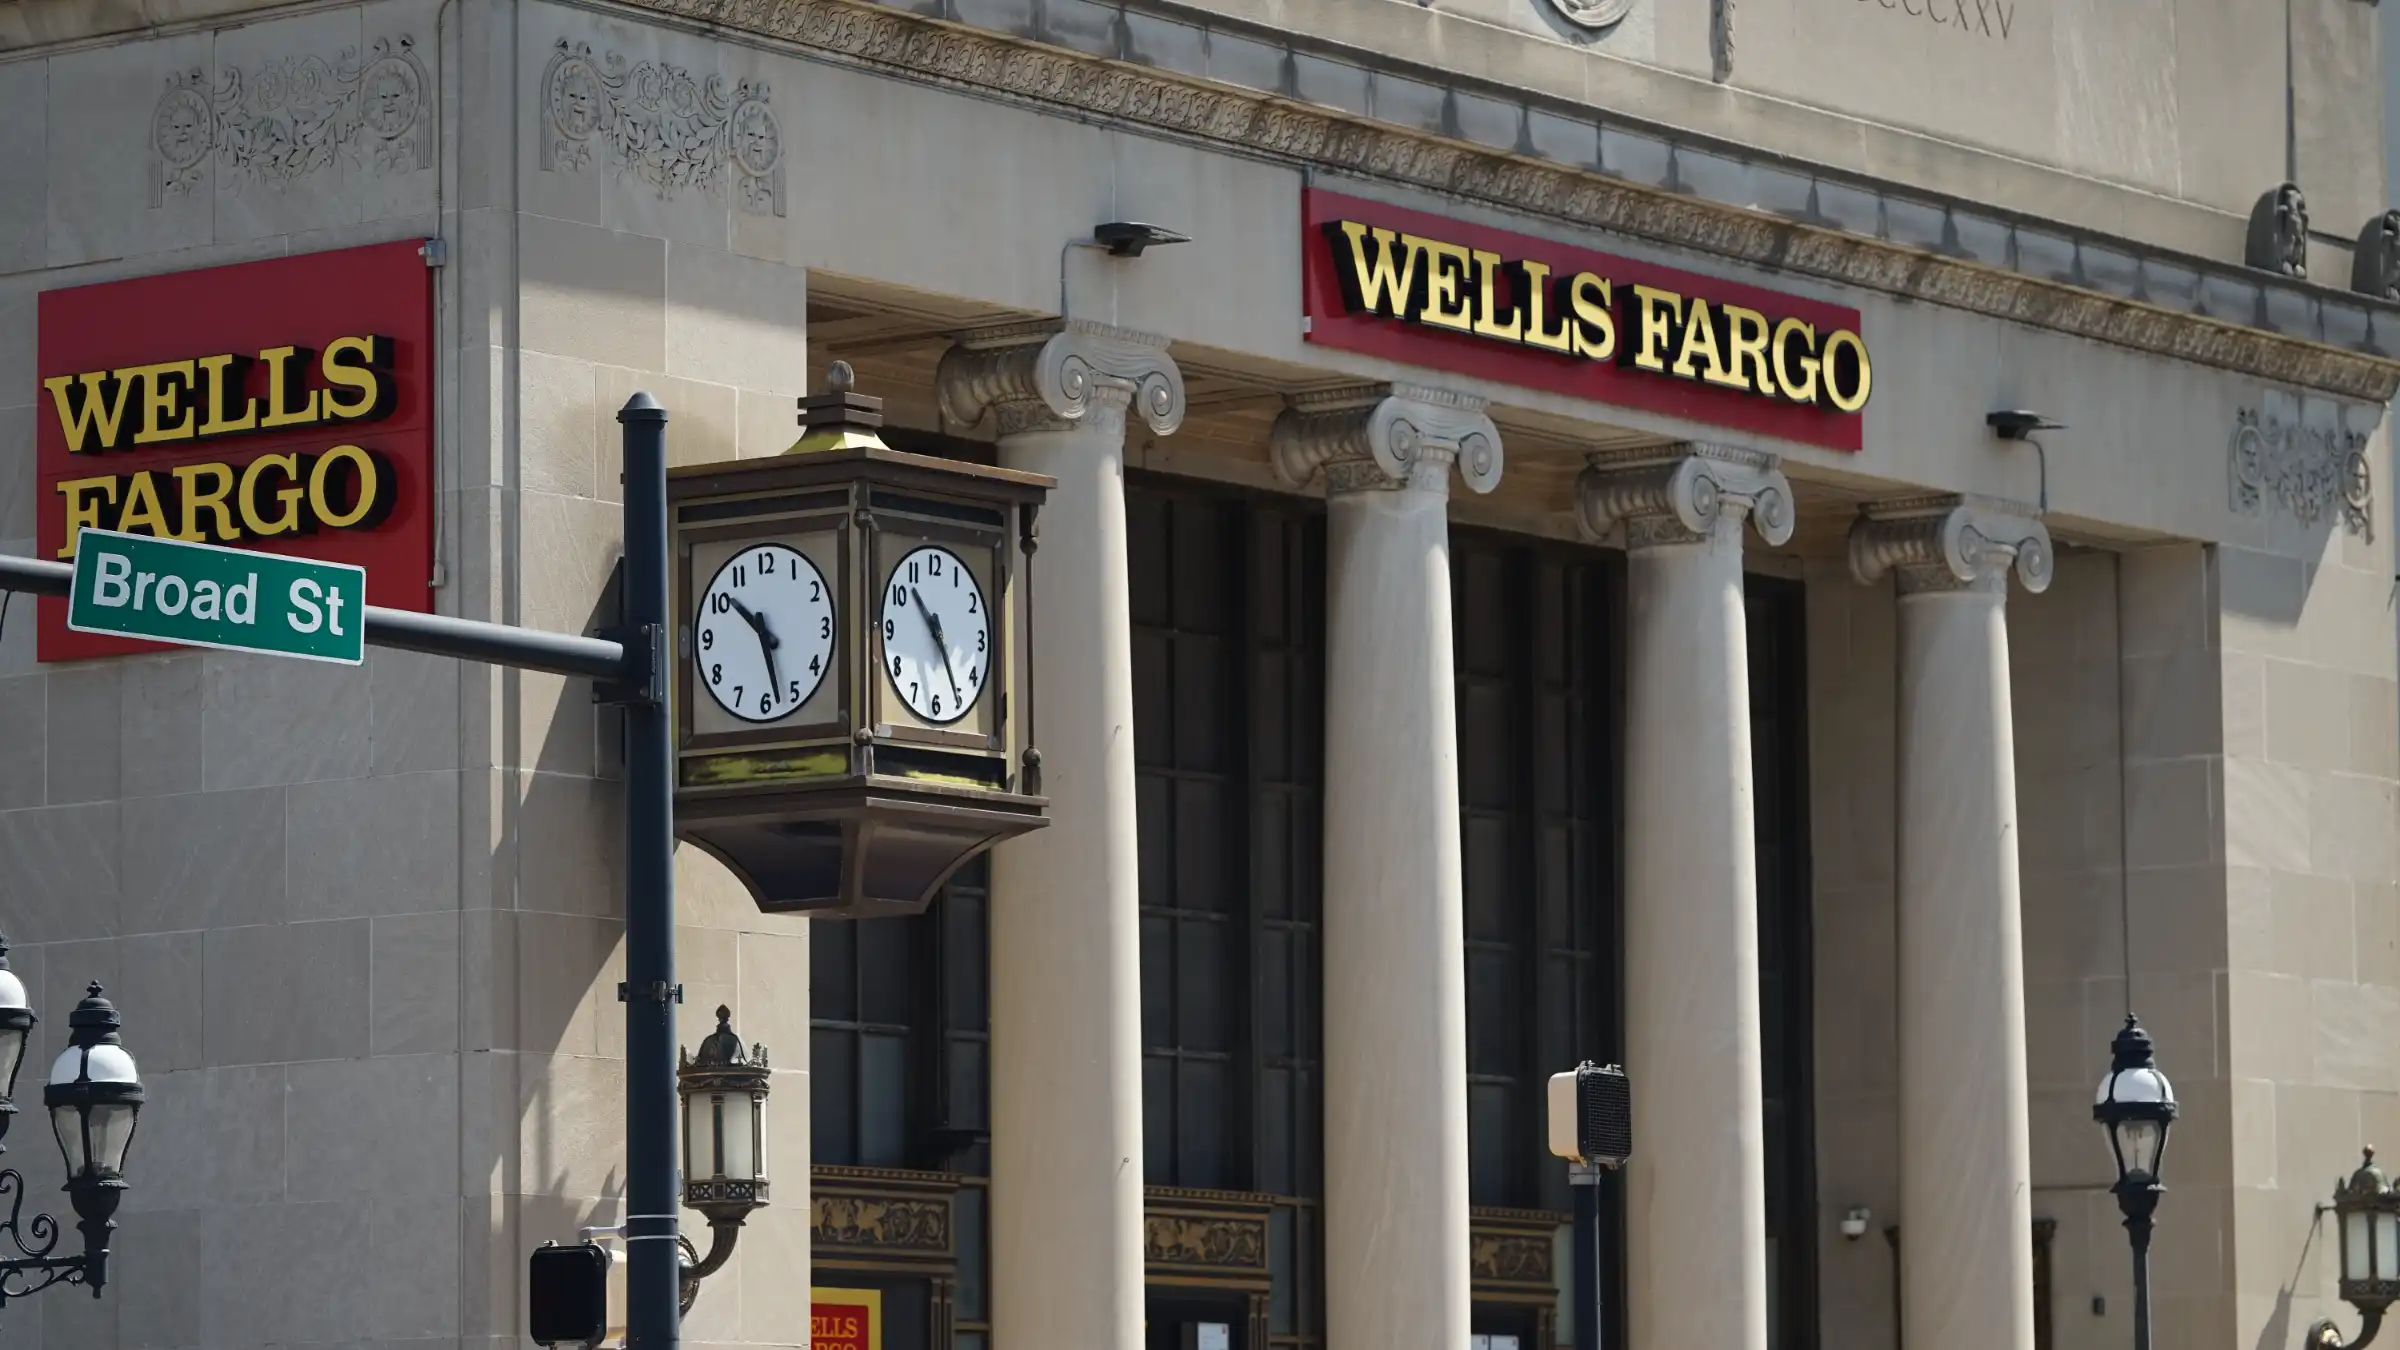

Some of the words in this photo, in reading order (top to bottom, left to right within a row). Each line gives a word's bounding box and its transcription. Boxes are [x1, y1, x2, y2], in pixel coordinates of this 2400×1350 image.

[1341, 219, 1616, 361] WELLS
[1633, 284, 1873, 413] FARGO
[43, 333, 379, 454] WELLS
[56, 444, 378, 560] FARGO
[758, 552, 775, 575] 12
[791, 558, 796, 581] 1
[908, 561, 919, 584] 11
[928, 554, 942, 576] 12
[732, 565, 746, 588] 11
[953, 566, 958, 588] 1
[91, 551, 258, 626] Broad
[286, 576, 345, 637] St
[809, 580, 821, 603] 2
[892, 584, 907, 607] 10
[968, 592, 977, 614] 2
[711, 592, 731, 615] 10
[820, 616, 831, 640] 3
[885, 619, 895, 641] 9
[701, 629, 714, 651] 9
[977, 630, 986, 653] 3
[711, 663, 723, 685] 8
[809, 654, 821, 677] 4
[893, 655, 902, 678] 8
[968, 666, 978, 688] 4
[733, 685, 744, 708] 7
[790, 680, 800, 703] 5
[909, 682, 918, 704] 7
[760, 692, 772, 715] 6
[931, 694, 941, 716] 6
[811, 1316, 859, 1339] ELLS
